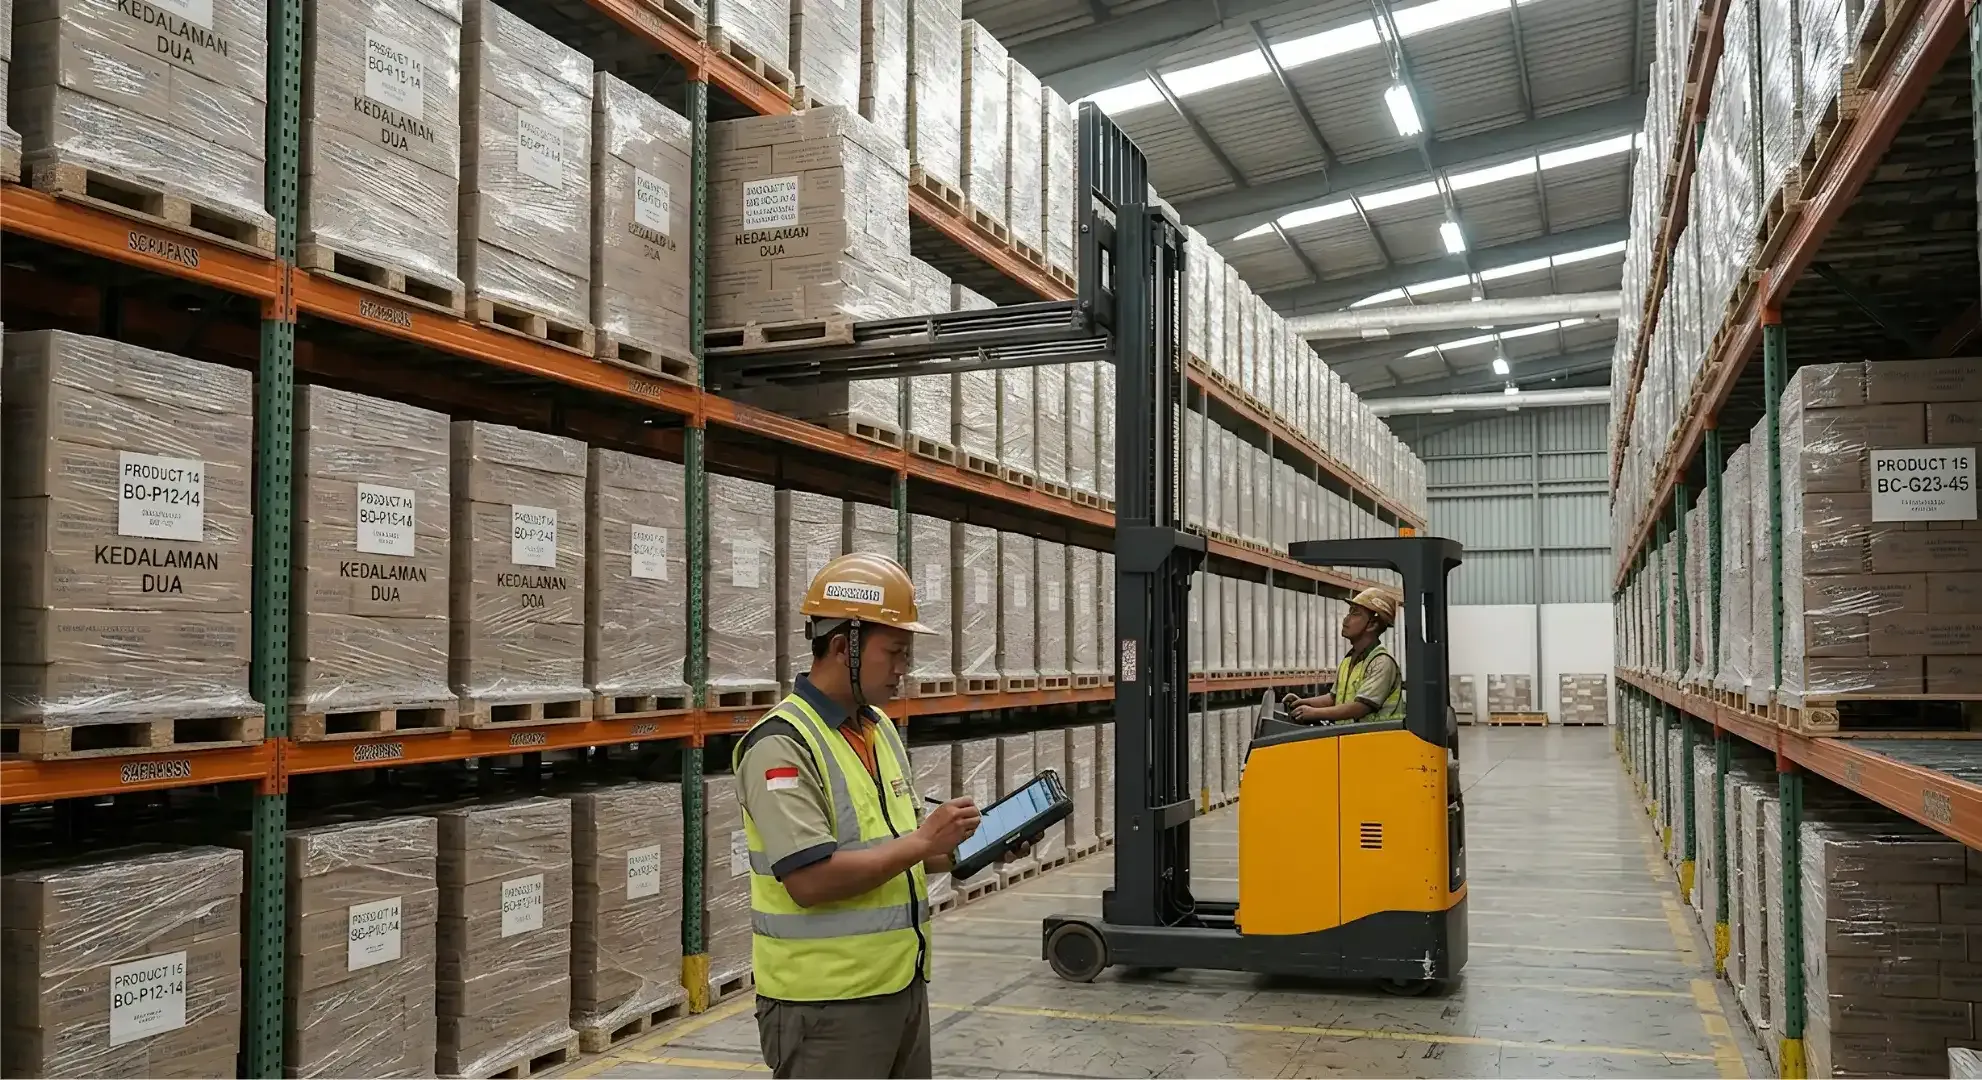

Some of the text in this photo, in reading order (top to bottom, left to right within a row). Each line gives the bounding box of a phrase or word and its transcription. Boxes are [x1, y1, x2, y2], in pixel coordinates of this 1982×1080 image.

[157, 35, 195, 65] DUA
[381, 127, 409, 151] DUA
[124, 463, 200, 484] PRODUCT 14
[1877, 458, 1947, 472] PRODUCT
[123, 483, 200, 507] BO-P12-14
[1877, 476, 1969, 494] BC-G23-45
[95, 544, 218, 571] KEDALAMAN
[340, 560, 427, 583] KEDALAMAN
[142, 573, 183, 594] DUA
[371, 585, 401, 602] DUA
[114, 966, 168, 990] PRODUCT
[114, 980, 183, 1010] BO-P12-14
